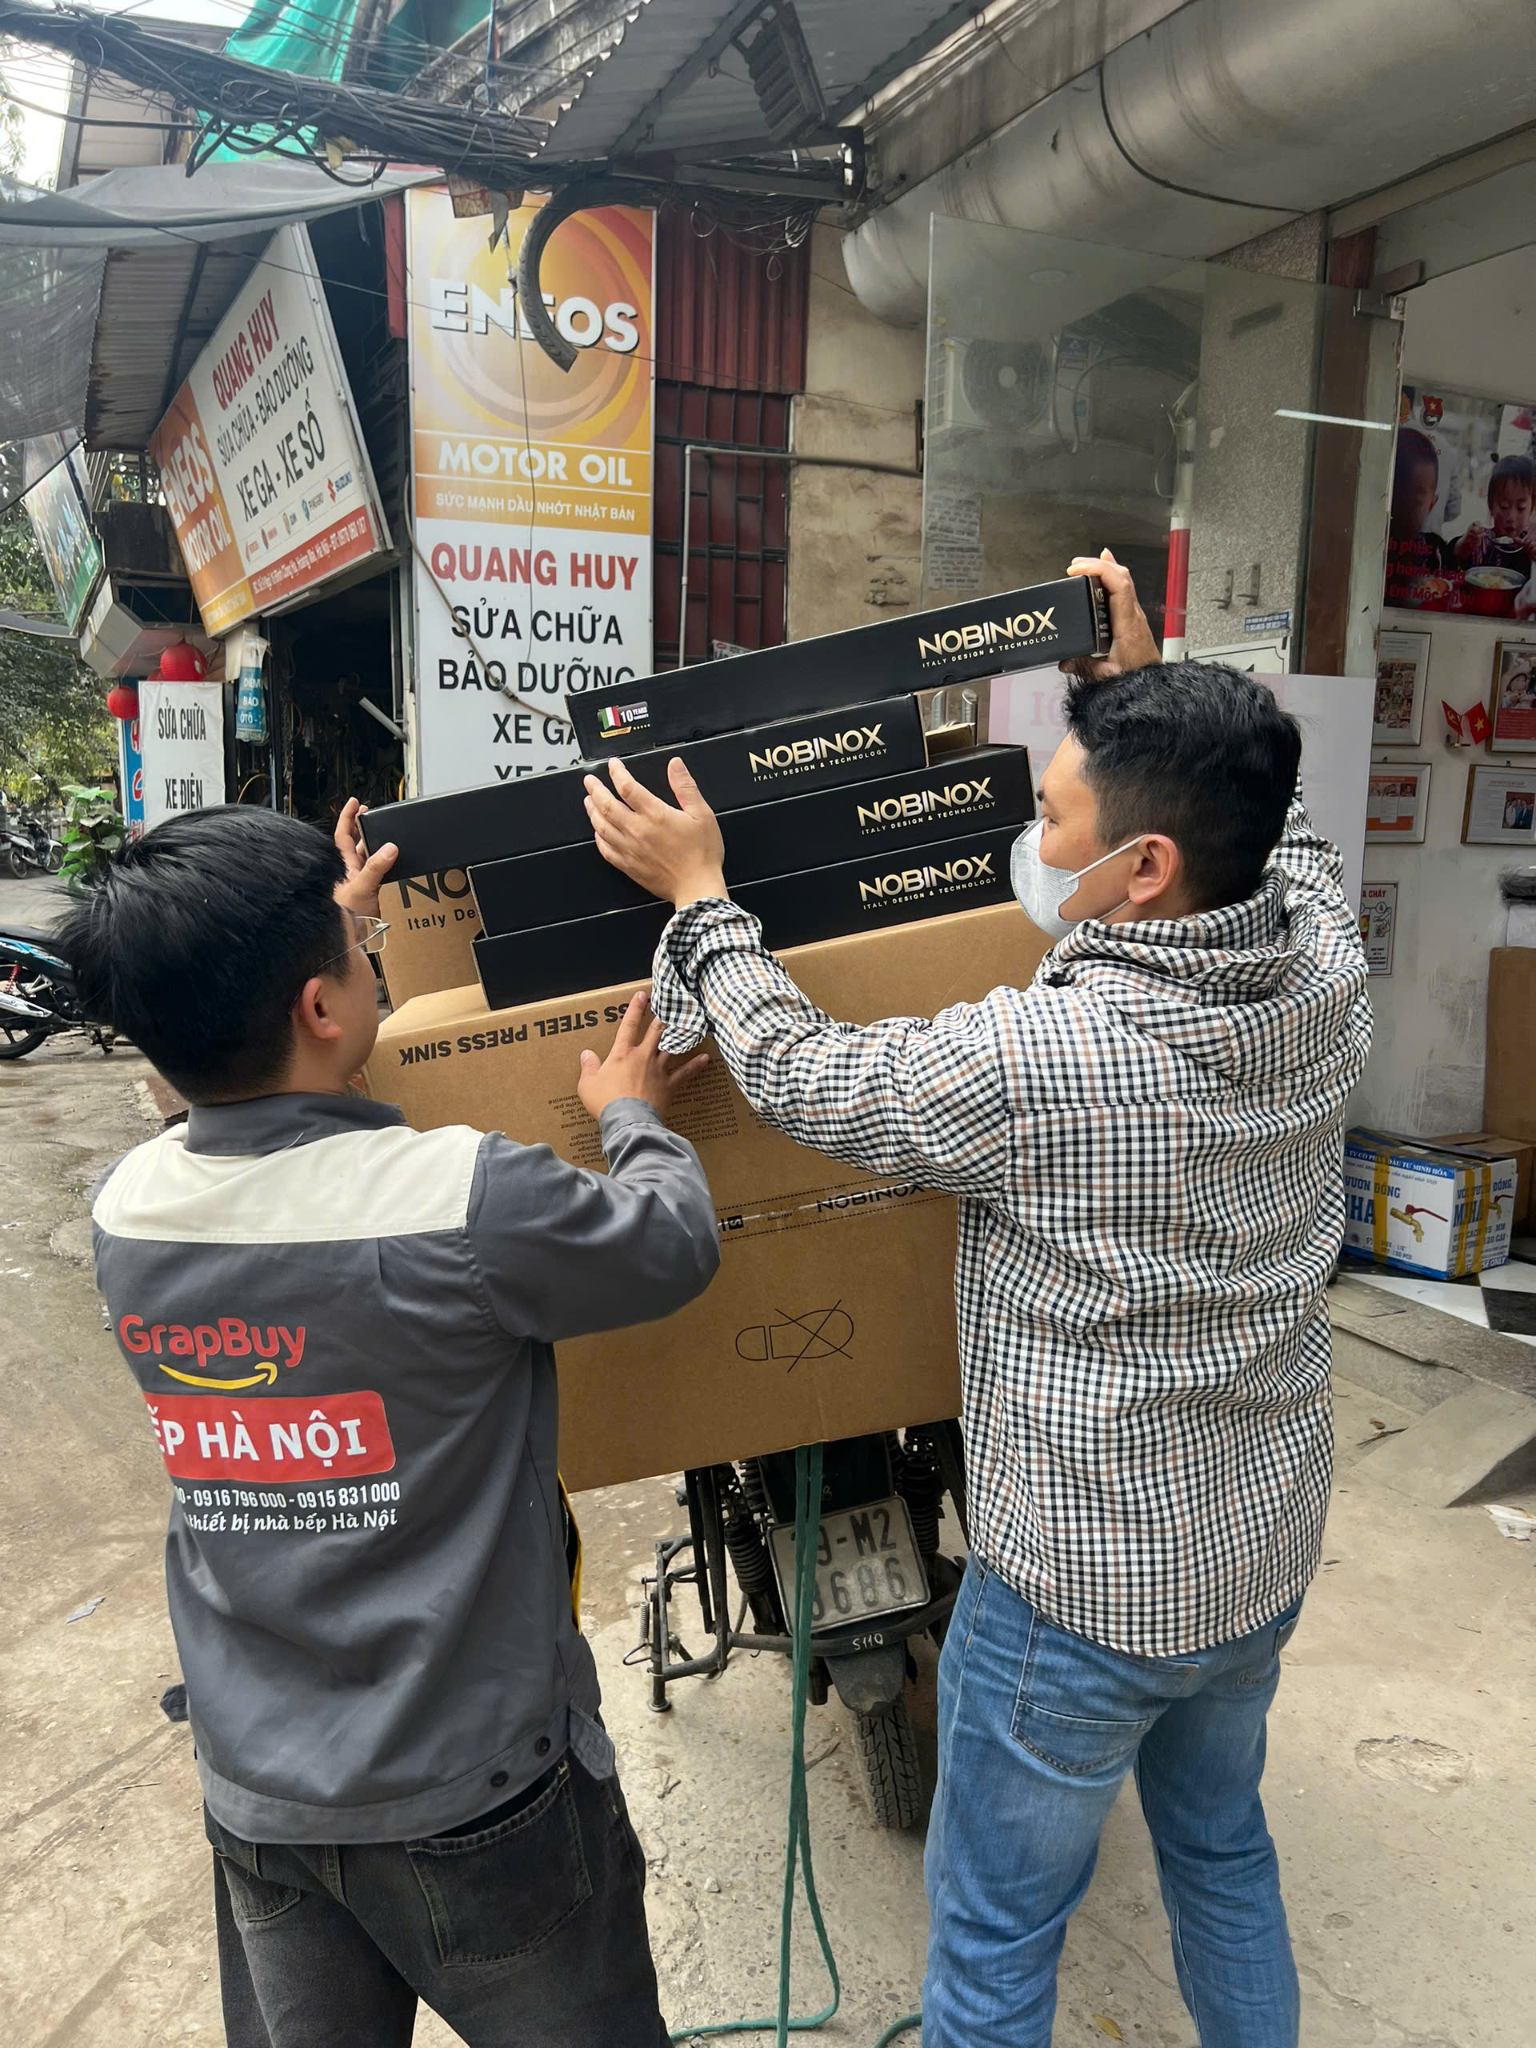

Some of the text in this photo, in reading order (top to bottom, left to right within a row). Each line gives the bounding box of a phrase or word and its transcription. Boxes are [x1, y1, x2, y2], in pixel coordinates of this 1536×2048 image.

[212, 288, 280, 411] QUANG HUY
[217, 424, 237, 467] SỬA
[232, 403, 258, 451] CHỮA
[256, 375, 278, 425] BẢO
[273, 336, 314, 405] DƯỠNG
[236, 473, 259, 522] XE
[252, 459, 278, 508] GA
[276, 432, 303, 488] XE
[297, 387, 326, 470] SỐ
[439, 440, 632, 486] MOTOR OIL
[160, 422, 214, 529] ENEOS
[436, 490, 635, 522] SỨC MẠNH DẦU NHỚT NHẬT BẢN
[181, 517, 217, 577] MOTOR
[208, 504, 232, 552] OIL
[431, 542, 639, 591] QUANG HUY
[451, 597, 623, 645] SỬA CHỮA
[918, 607, 1057, 659] NOBINOX
[438, 650, 507, 691] BẢO
[922, 658, 947, 668] ITALY
[951, 650, 984, 662] DESIGN
[999, 634, 1060, 652] TECHNOLOGY
[158, 697, 206, 740] SỬA CHỮA
[493, 714, 533, 744] XE
[620, 710, 634, 723] 10
[748, 723, 885, 773] NOBINOX
[753, 772, 778, 782] ITALY
[783, 764, 816, 776] DESIGN
[829, 749, 888, 765] TECHNOLOGY
[165, 778, 178, 809] XE
[857, 777, 994, 826] NOBINOX
[861, 825, 886, 835] ITALY
[890, 817, 924, 829] DESIGN
[937, 801, 996, 819] TECHNOLOGY
[859, 853, 995, 902] NOBINOX
[863, 900, 888, 910] ITALY
[892, 893, 925, 904] DESIGN
[939, 877, 997, 894] TECHNOLOGY
[408, 912, 446, 930] Italy
[457, 1023, 528, 1054] PRESS
[534, 1009, 599, 1037] STEEL
[398, 1040, 452, 1066] SINK
[1413, 1164, 1432, 1173] MINH
[118, 1314, 306, 1368] GrapBuy
[196, 1410, 260, 1461] HÀ
[269, 1409, 367, 1467] NỘI
[193, 1489, 231, 1507] 0916
[231, 1489, 258, 1508] 796
[259, 1492, 287, 1508] 000
[297, 1489, 338, 1509] 0915
[338, 1485, 368, 1507] 831
[371, 1481, 401, 1503] 000
[188, 1508, 398, 1535] thiết bị nhà bếp Hà Nội
